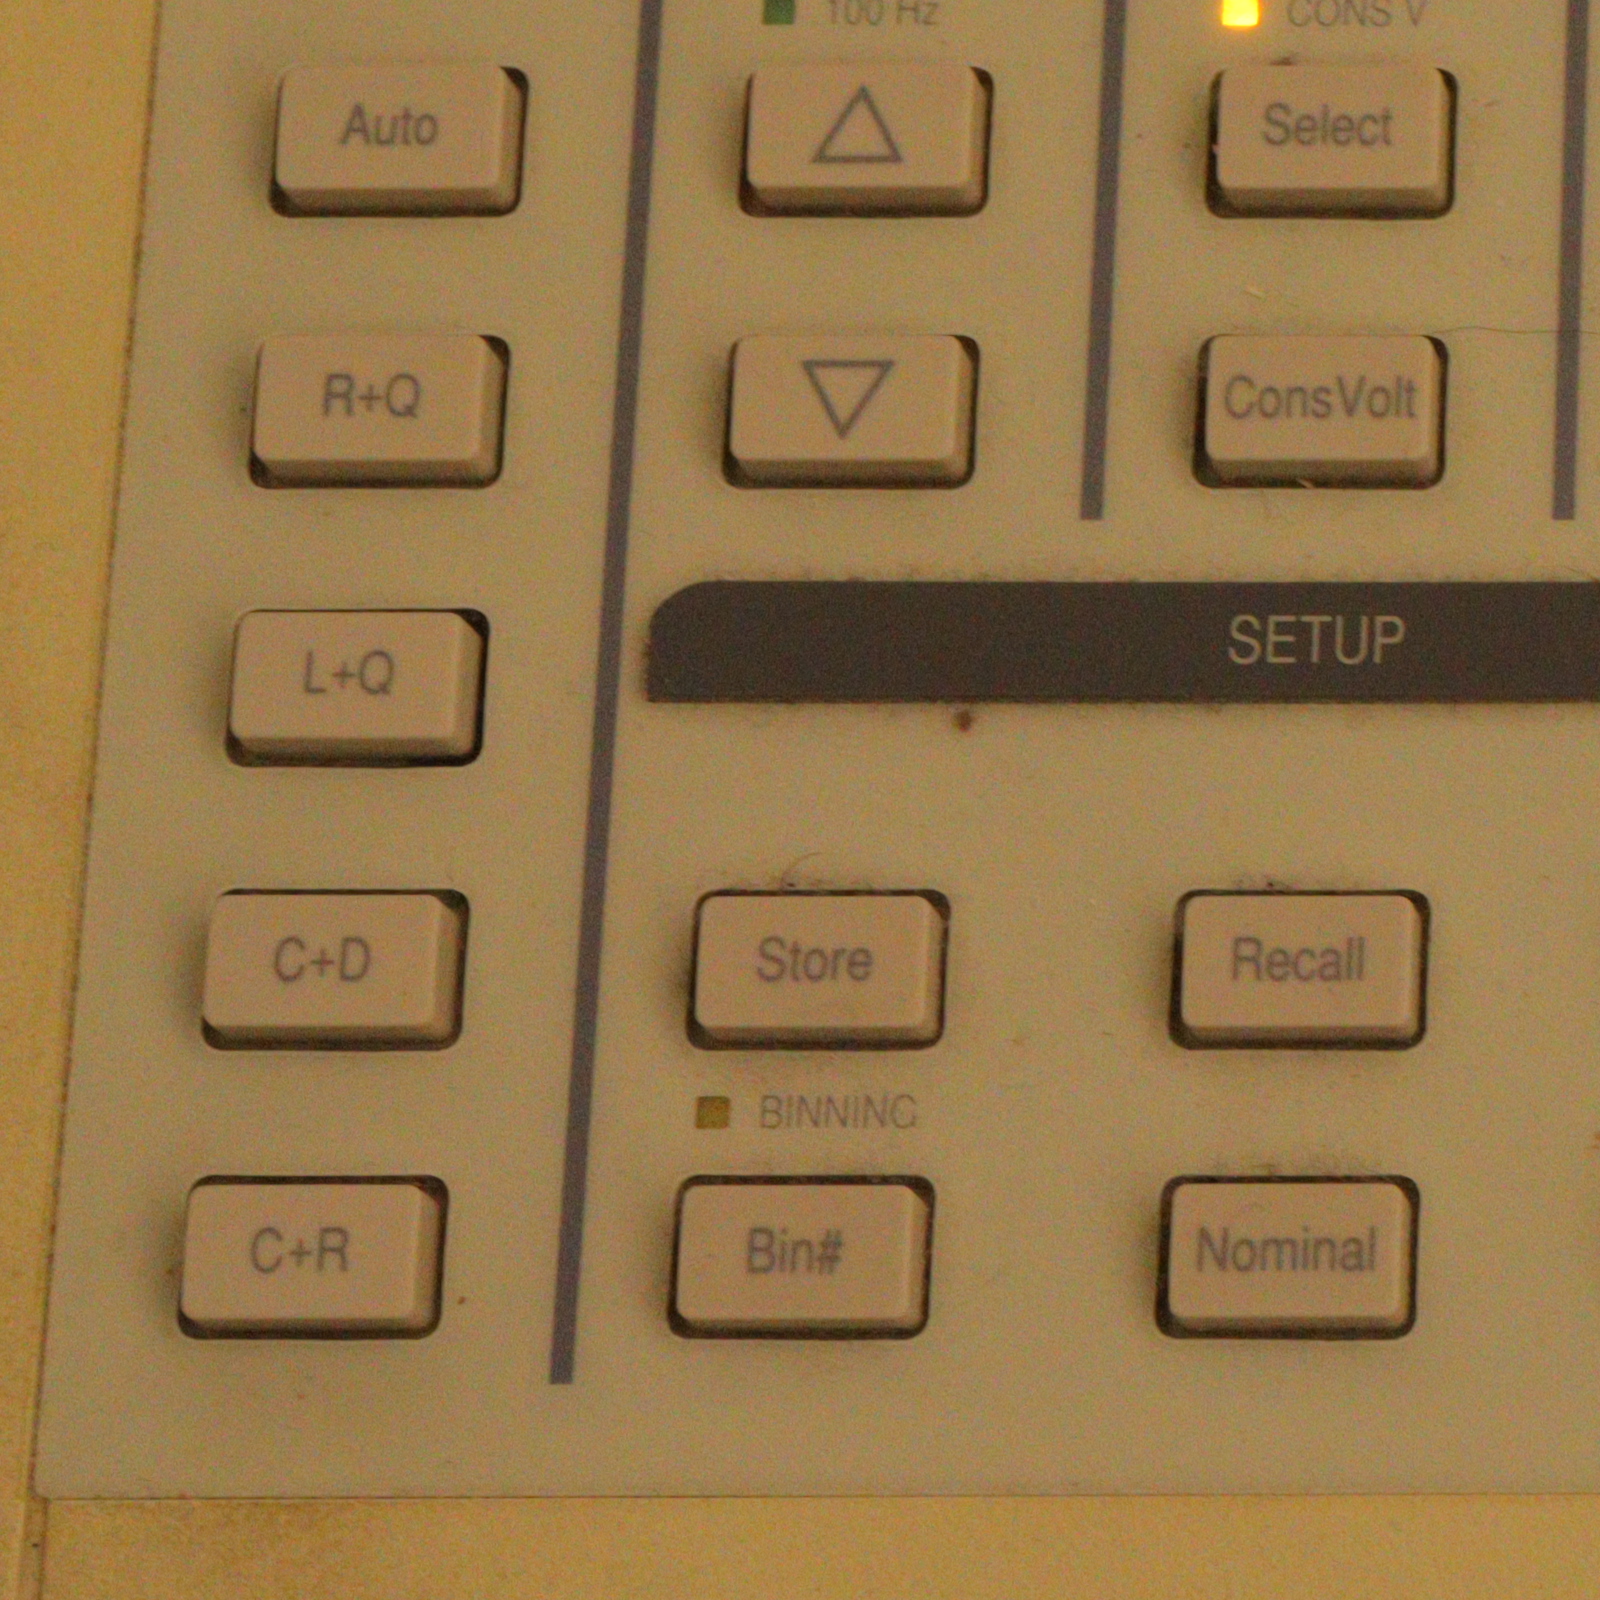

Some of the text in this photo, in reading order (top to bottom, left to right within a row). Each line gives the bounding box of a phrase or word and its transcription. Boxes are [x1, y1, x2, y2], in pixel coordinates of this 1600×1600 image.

[337, 102, 440, 148] Auto
[1261, 100, 1394, 149] Select
[321, 371, 422, 420] R+Q
[1224, 373, 1416, 421] ConsVolt
[1227, 613, 1406, 666] SETUP
[302, 648, 396, 697] L+Q
[271, 934, 373, 986] C+D
[755, 934, 875, 985] Store
[1230, 934, 1366, 984] Recall
[759, 1092, 919, 1131] BINNING
[249, 1225, 351, 1276] C+R
[745, 1225, 846, 1276] Bin#
[1195, 1225, 1378, 1274] Nominal
